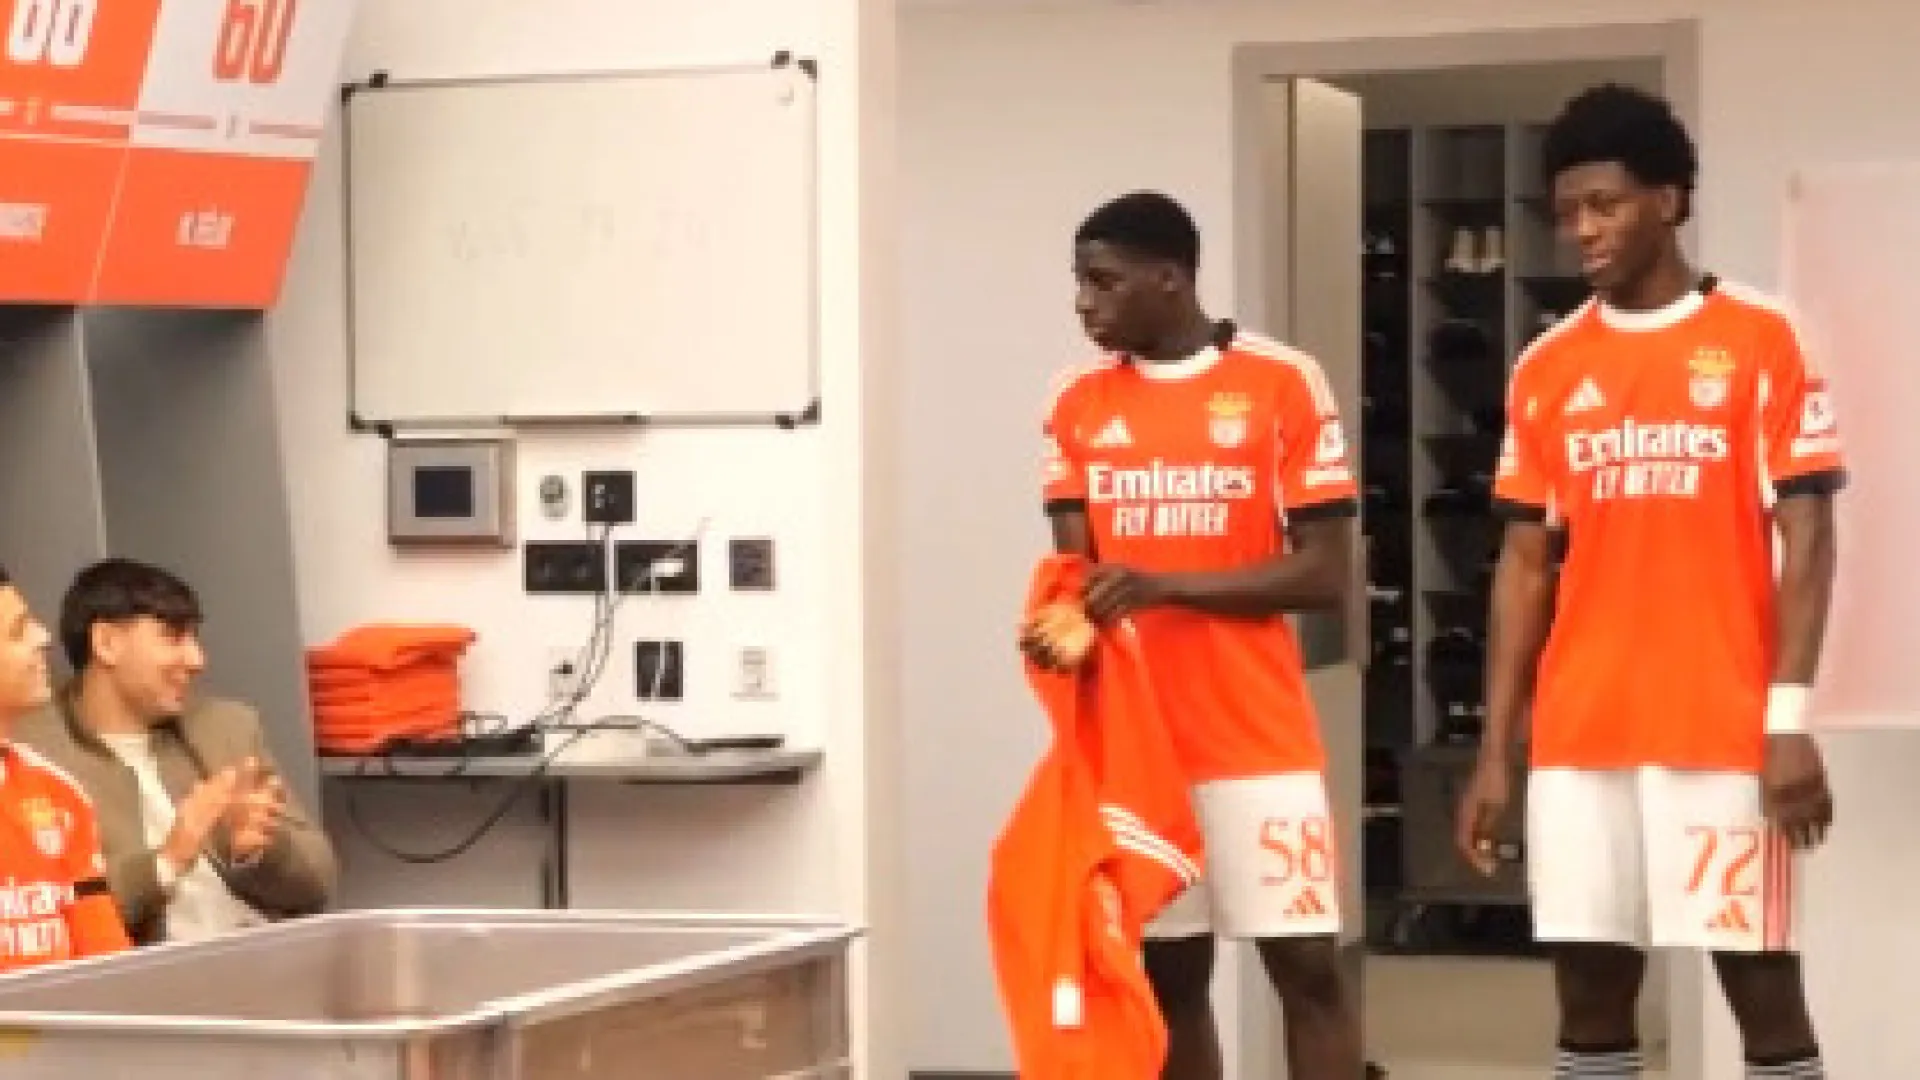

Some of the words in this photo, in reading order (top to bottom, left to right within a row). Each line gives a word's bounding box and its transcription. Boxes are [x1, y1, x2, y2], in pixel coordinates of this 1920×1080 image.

[1088, 458, 1255, 501] Emirates
[1260, 818, 1329, 886] 58
[1684, 826, 1759, 895] 72
